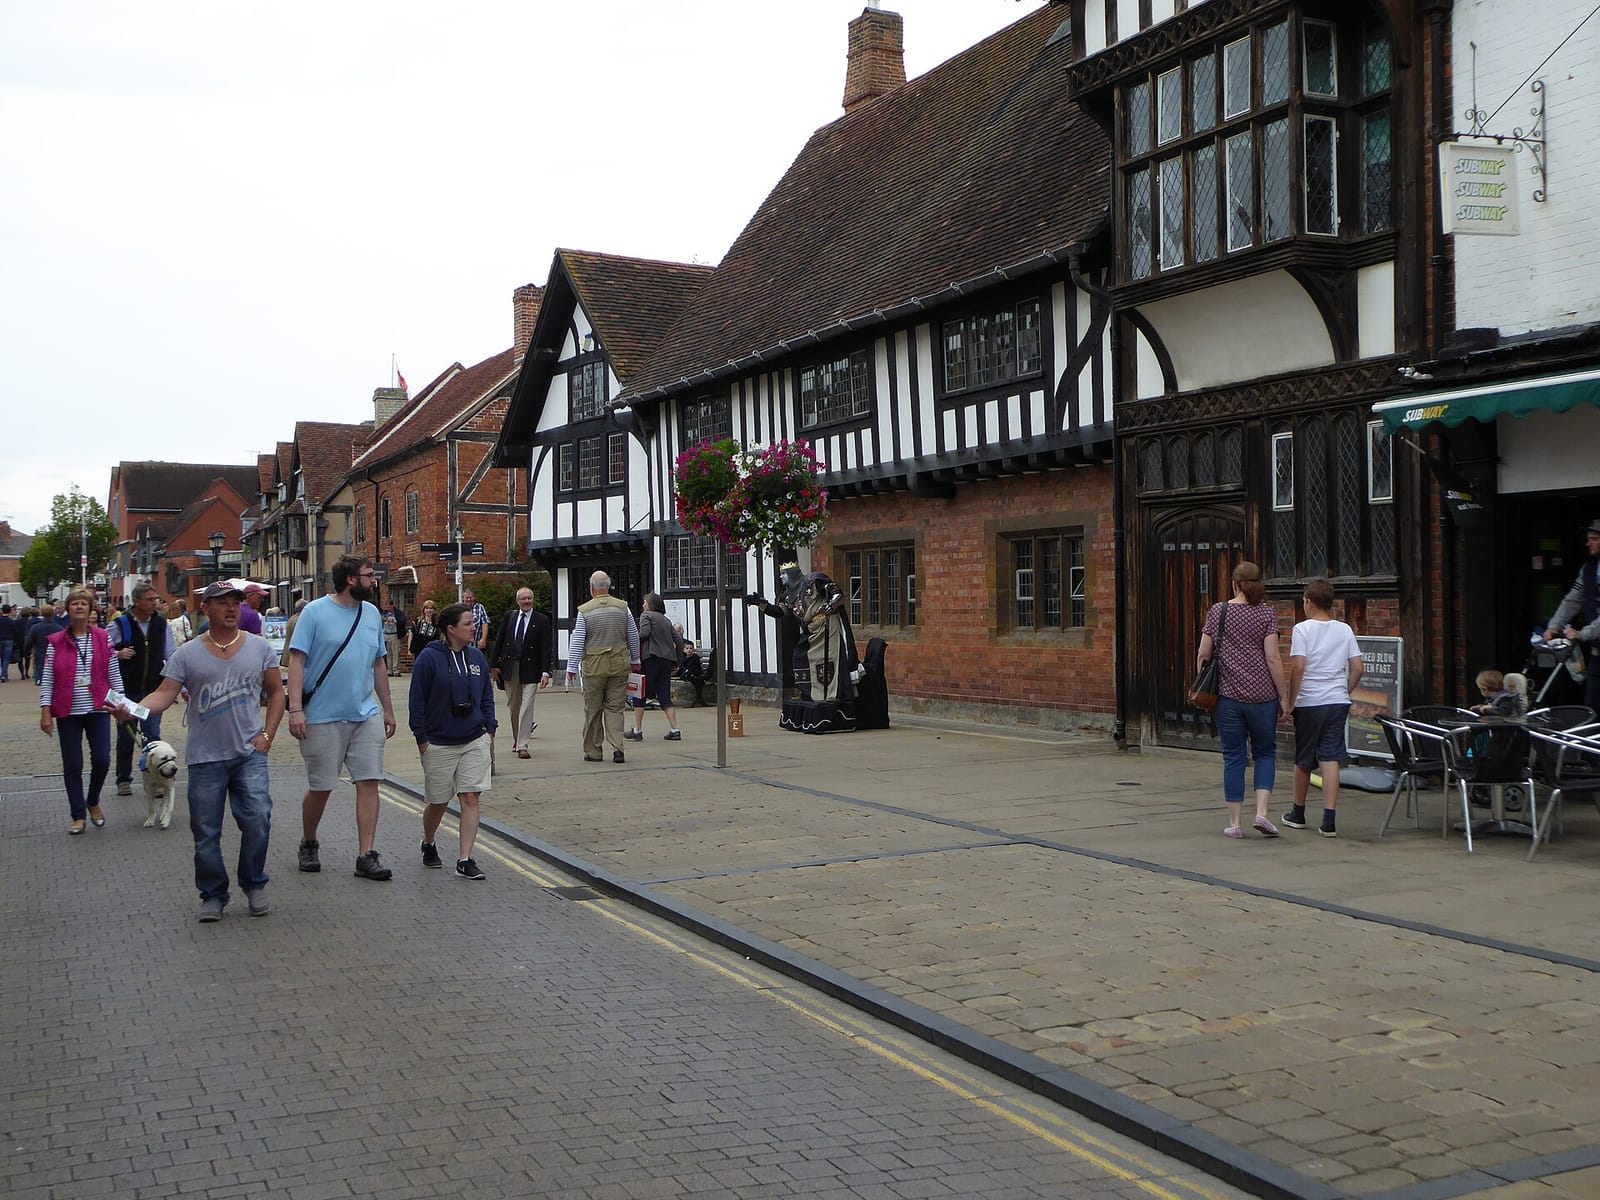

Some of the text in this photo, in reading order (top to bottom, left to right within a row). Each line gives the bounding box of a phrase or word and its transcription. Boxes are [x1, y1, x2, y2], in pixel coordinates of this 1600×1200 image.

[1454, 158, 1505, 175] SUBWAY
[1455, 181, 1507, 198] SUBWAY
[1456, 204, 1509, 221] SUBWAY
[1402, 404, 1449, 423] SUBWAY
[1375, 663, 1392, 674] FAST.
